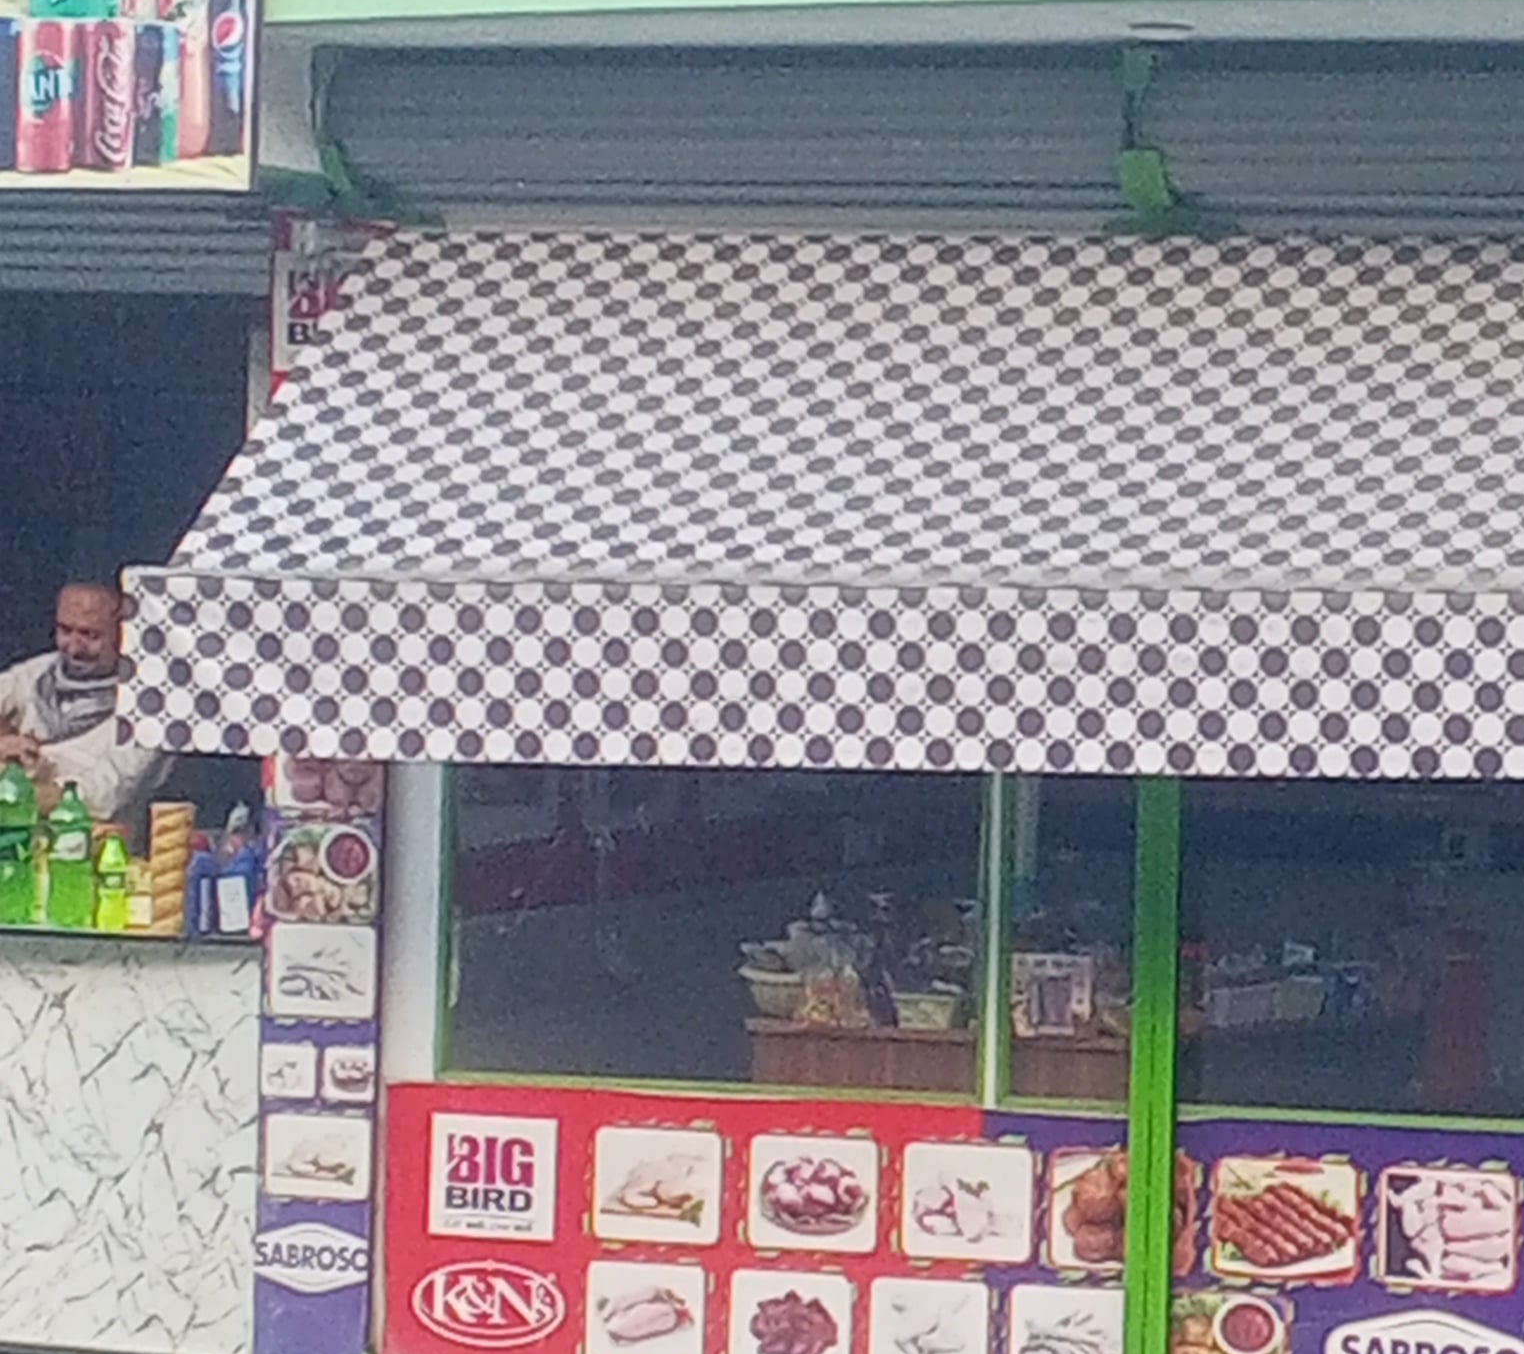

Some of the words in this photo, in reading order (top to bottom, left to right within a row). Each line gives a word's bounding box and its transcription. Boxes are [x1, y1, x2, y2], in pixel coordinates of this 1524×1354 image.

[447, 1133, 535, 1188] BIG
[445, 1185, 533, 1213] BIRD
[253, 1241, 369, 1274] SABROSO
